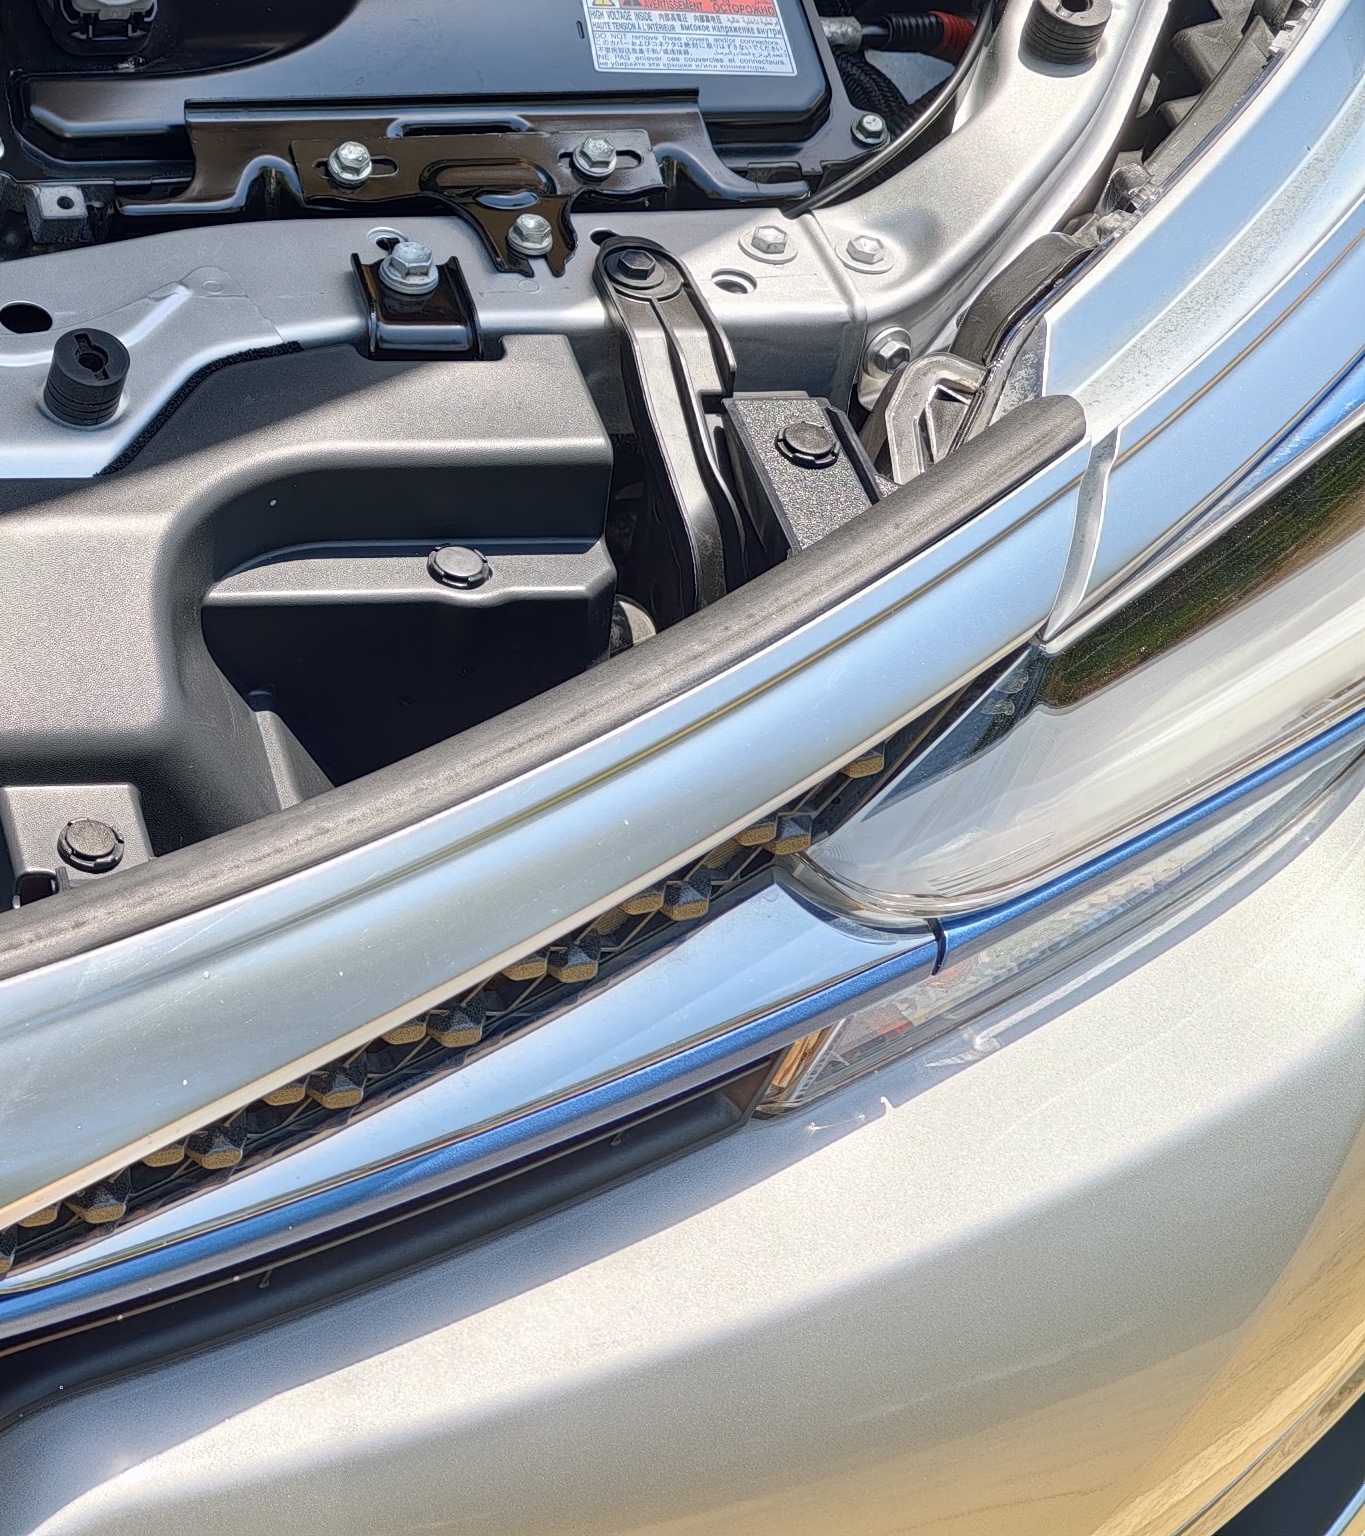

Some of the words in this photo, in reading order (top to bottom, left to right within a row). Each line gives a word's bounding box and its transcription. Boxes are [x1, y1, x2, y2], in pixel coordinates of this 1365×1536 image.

[644, 0, 703, 12] AVERTISSEMENT
[713, 2, 775, 15] ОСТОРОЖНО
[590, 10, 604, 21] HIGH
[607, 10, 632, 21] VOLTAGE
[634, 12, 653, 22] INSIDE
[592, 21, 611, 30] HAUTE
[612, 22, 636, 30] TENSION
[643, 21, 676, 31] L'INTÉRIEUR
[680, 24, 710, 32] высокое
[712, 24, 755, 36] напряжение
[756, 28, 782, 37] внутри
[740, 38, 781, 46] connectors.
[611, 60, 646, 68] убирайте
